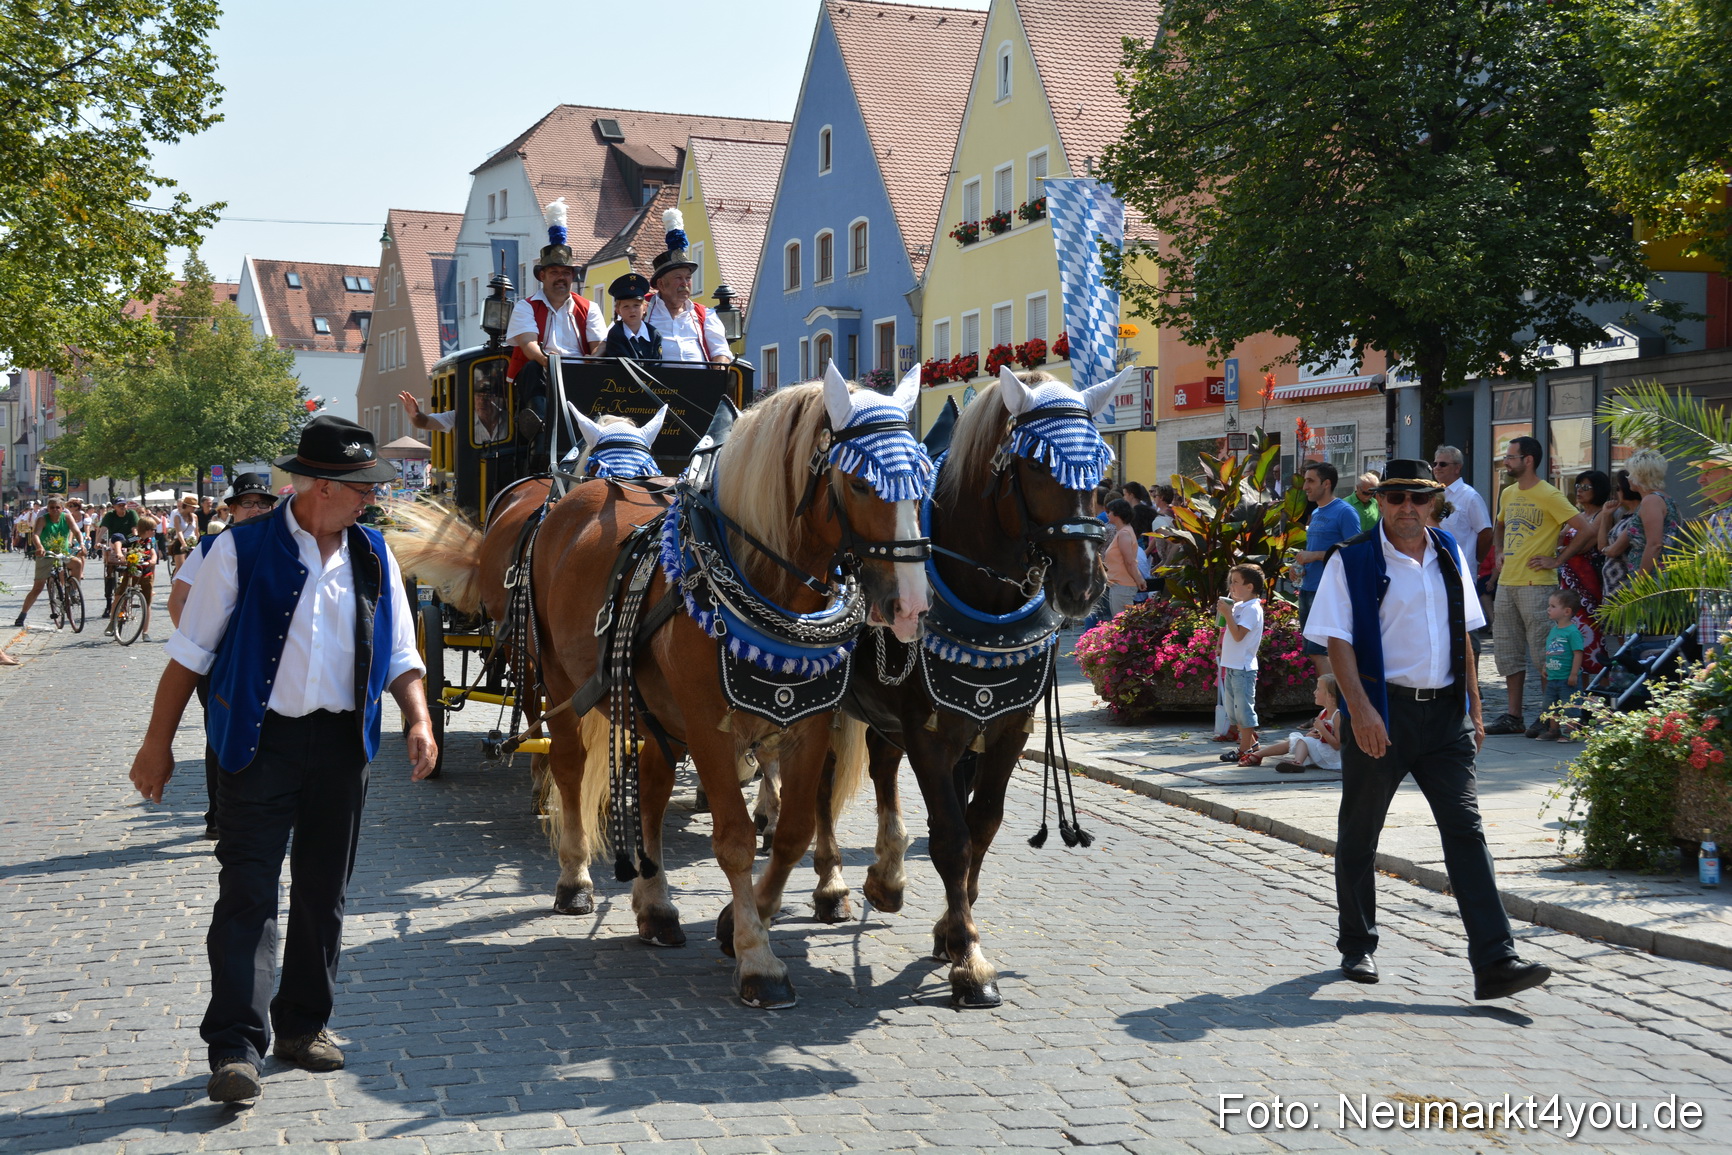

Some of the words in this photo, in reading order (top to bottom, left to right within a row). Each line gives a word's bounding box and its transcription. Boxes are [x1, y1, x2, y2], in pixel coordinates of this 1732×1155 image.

[601, 379, 626, 393] Das
[628, 381, 679, 395] Museum
[1210, 381, 1225, 395] DE
[1144, 370, 1152, 425] KINO
[585, 396, 606, 417] für
[661, 419, 681, 435] ahrt
